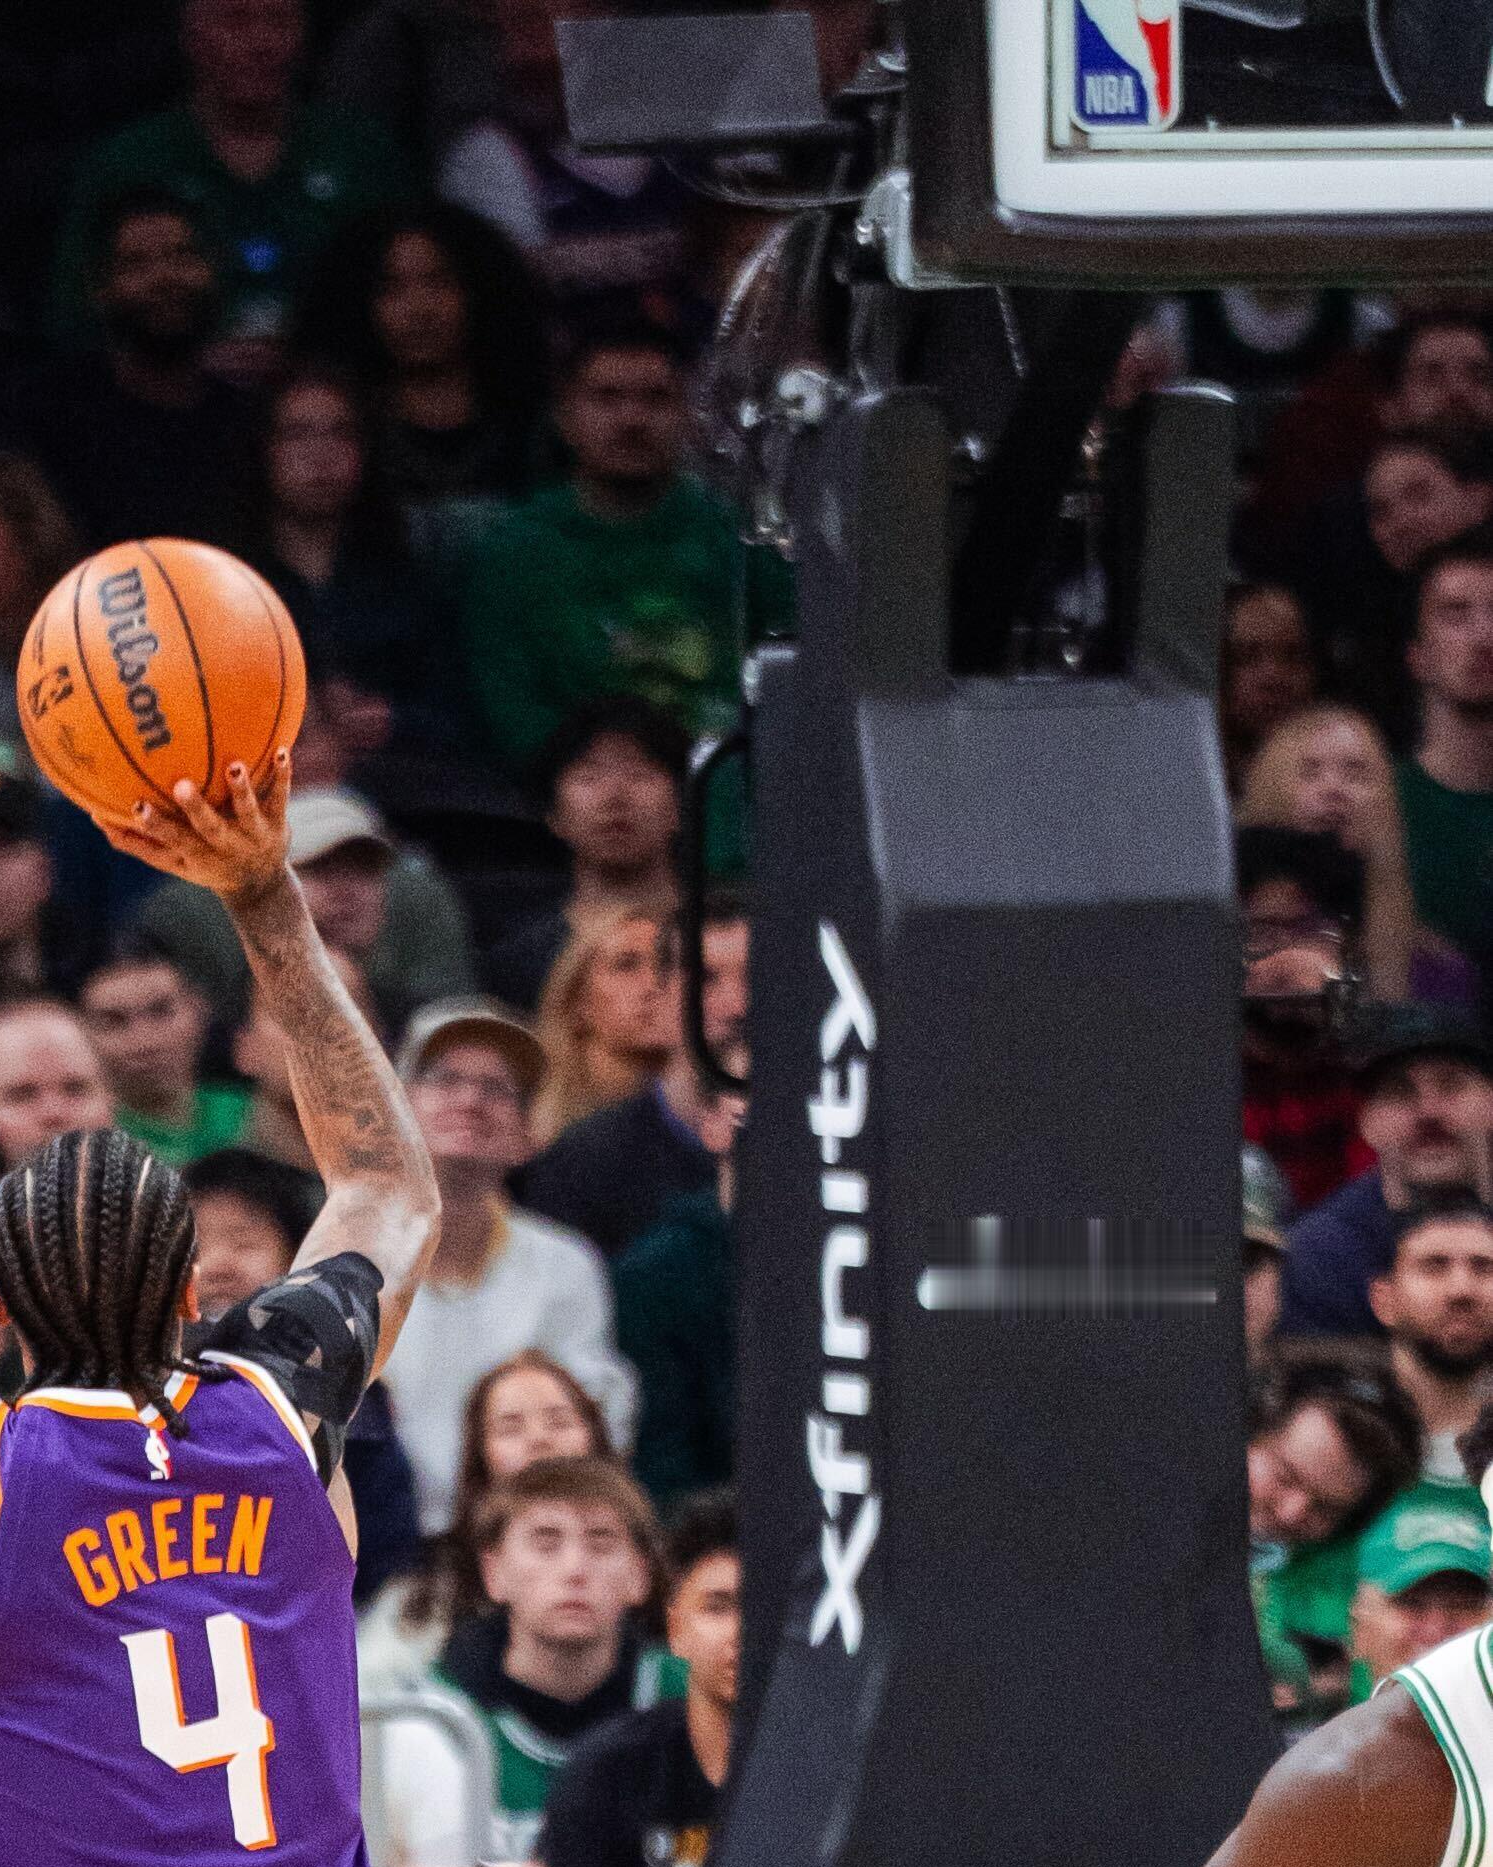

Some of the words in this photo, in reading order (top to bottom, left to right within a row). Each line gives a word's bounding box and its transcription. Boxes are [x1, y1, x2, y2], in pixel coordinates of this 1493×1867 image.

[1084, 74, 1136, 115] NBA
[97, 566, 174, 753] Wilson
[807, 920, 882, 1656] xfinity
[62, 1493, 274, 1607] GREEN
[118, 1611, 278, 1851] 4
